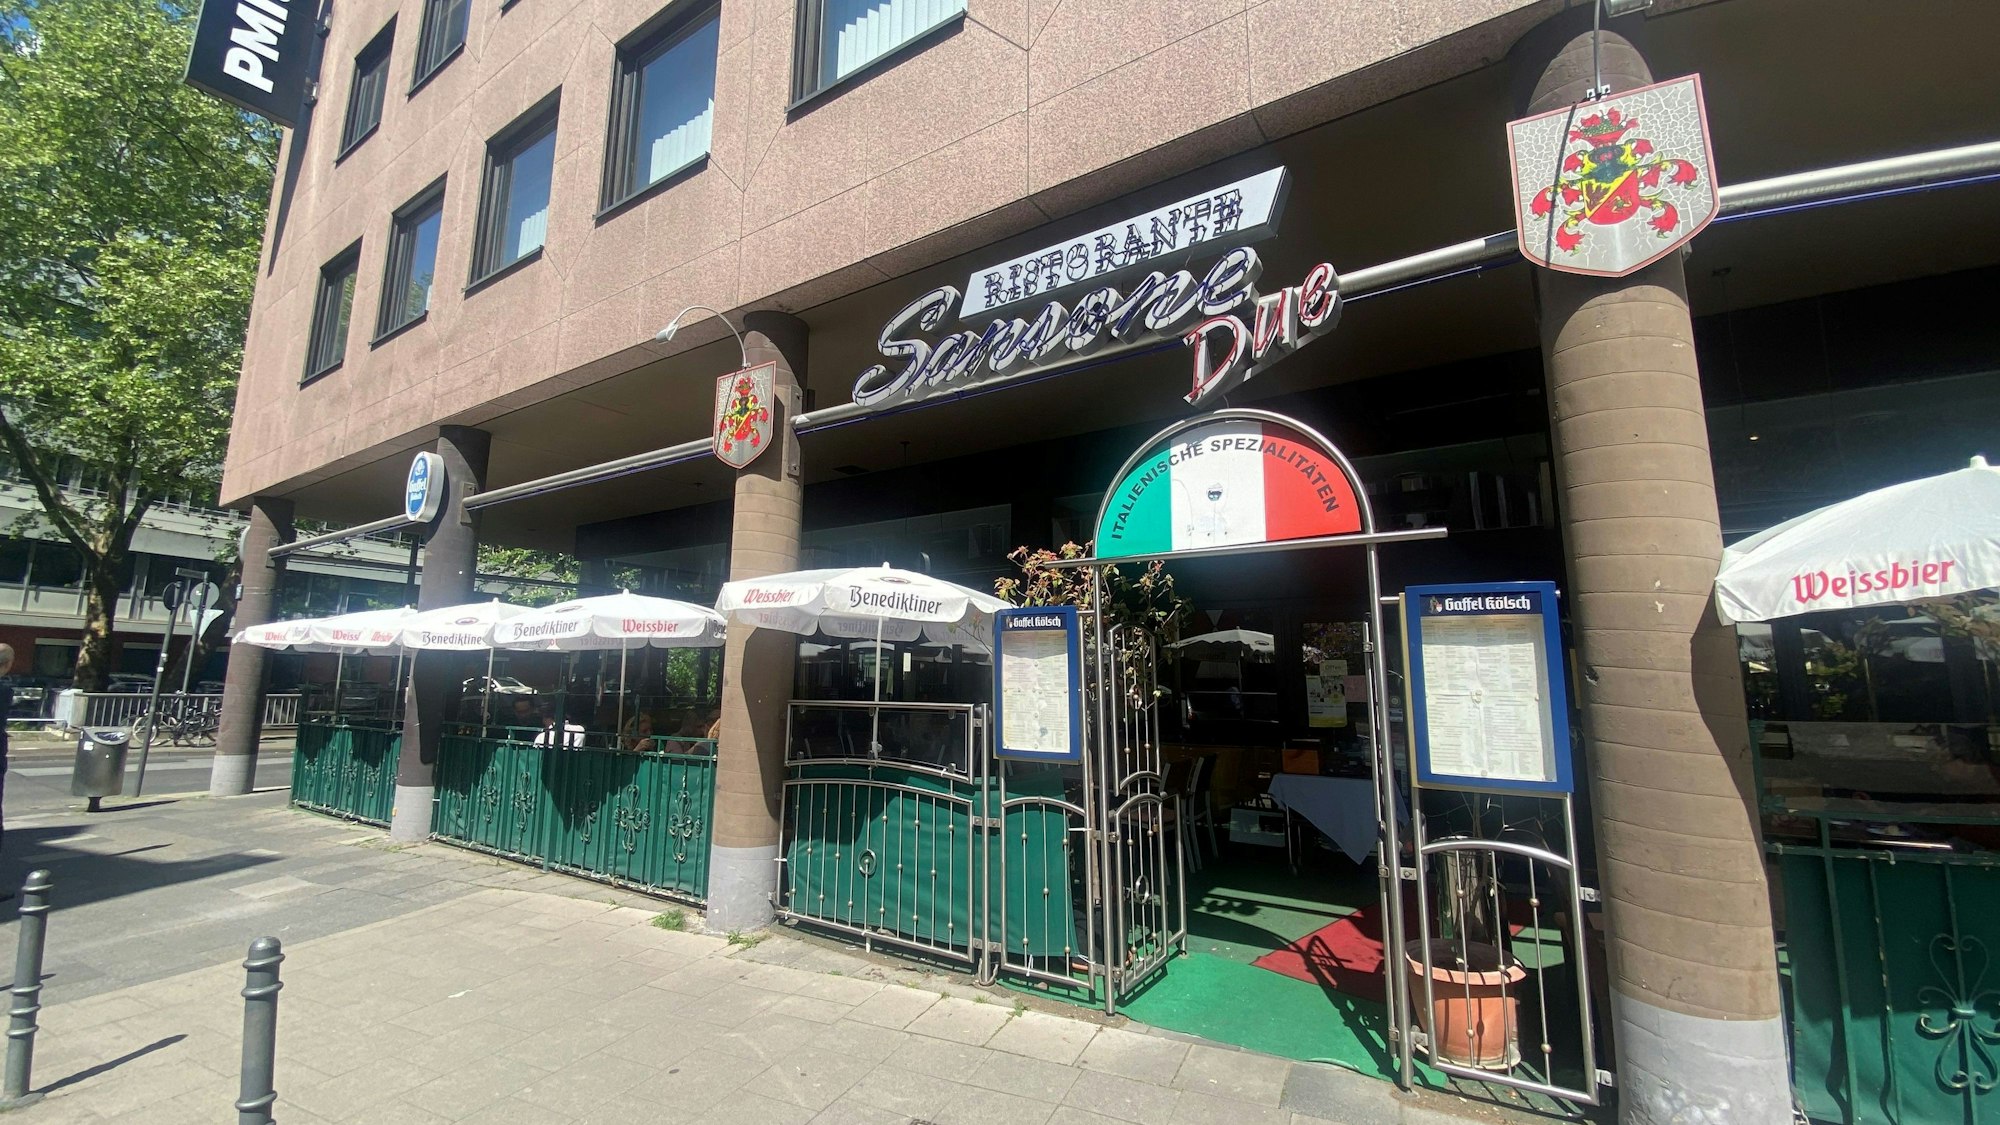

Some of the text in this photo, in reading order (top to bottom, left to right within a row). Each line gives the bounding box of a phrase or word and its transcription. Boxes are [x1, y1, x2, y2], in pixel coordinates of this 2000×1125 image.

[223, 0, 290, 94] PMI
[984, 188, 1244, 308] RISTORANTE
[851, 246, 1263, 410] Sansone
[1183, 262, 1343, 406] Due
[1111, 437, 1340, 540] ITALIENISCHE SPEZIALITÄTEN
[743, 588, 795, 606] Weissbier
[1791, 559, 1955, 604] Weissbier
[849, 584, 943, 615] Benediktiner
[1445, 594, 1532, 612] Gaffel Kölsch
[513, 620, 579, 638] Benediktiner
[622, 618, 679, 634] Weissbier
[1013, 615, 1062, 628] Gaffel Kölsch
[421, 631, 483, 646] Benediktine
